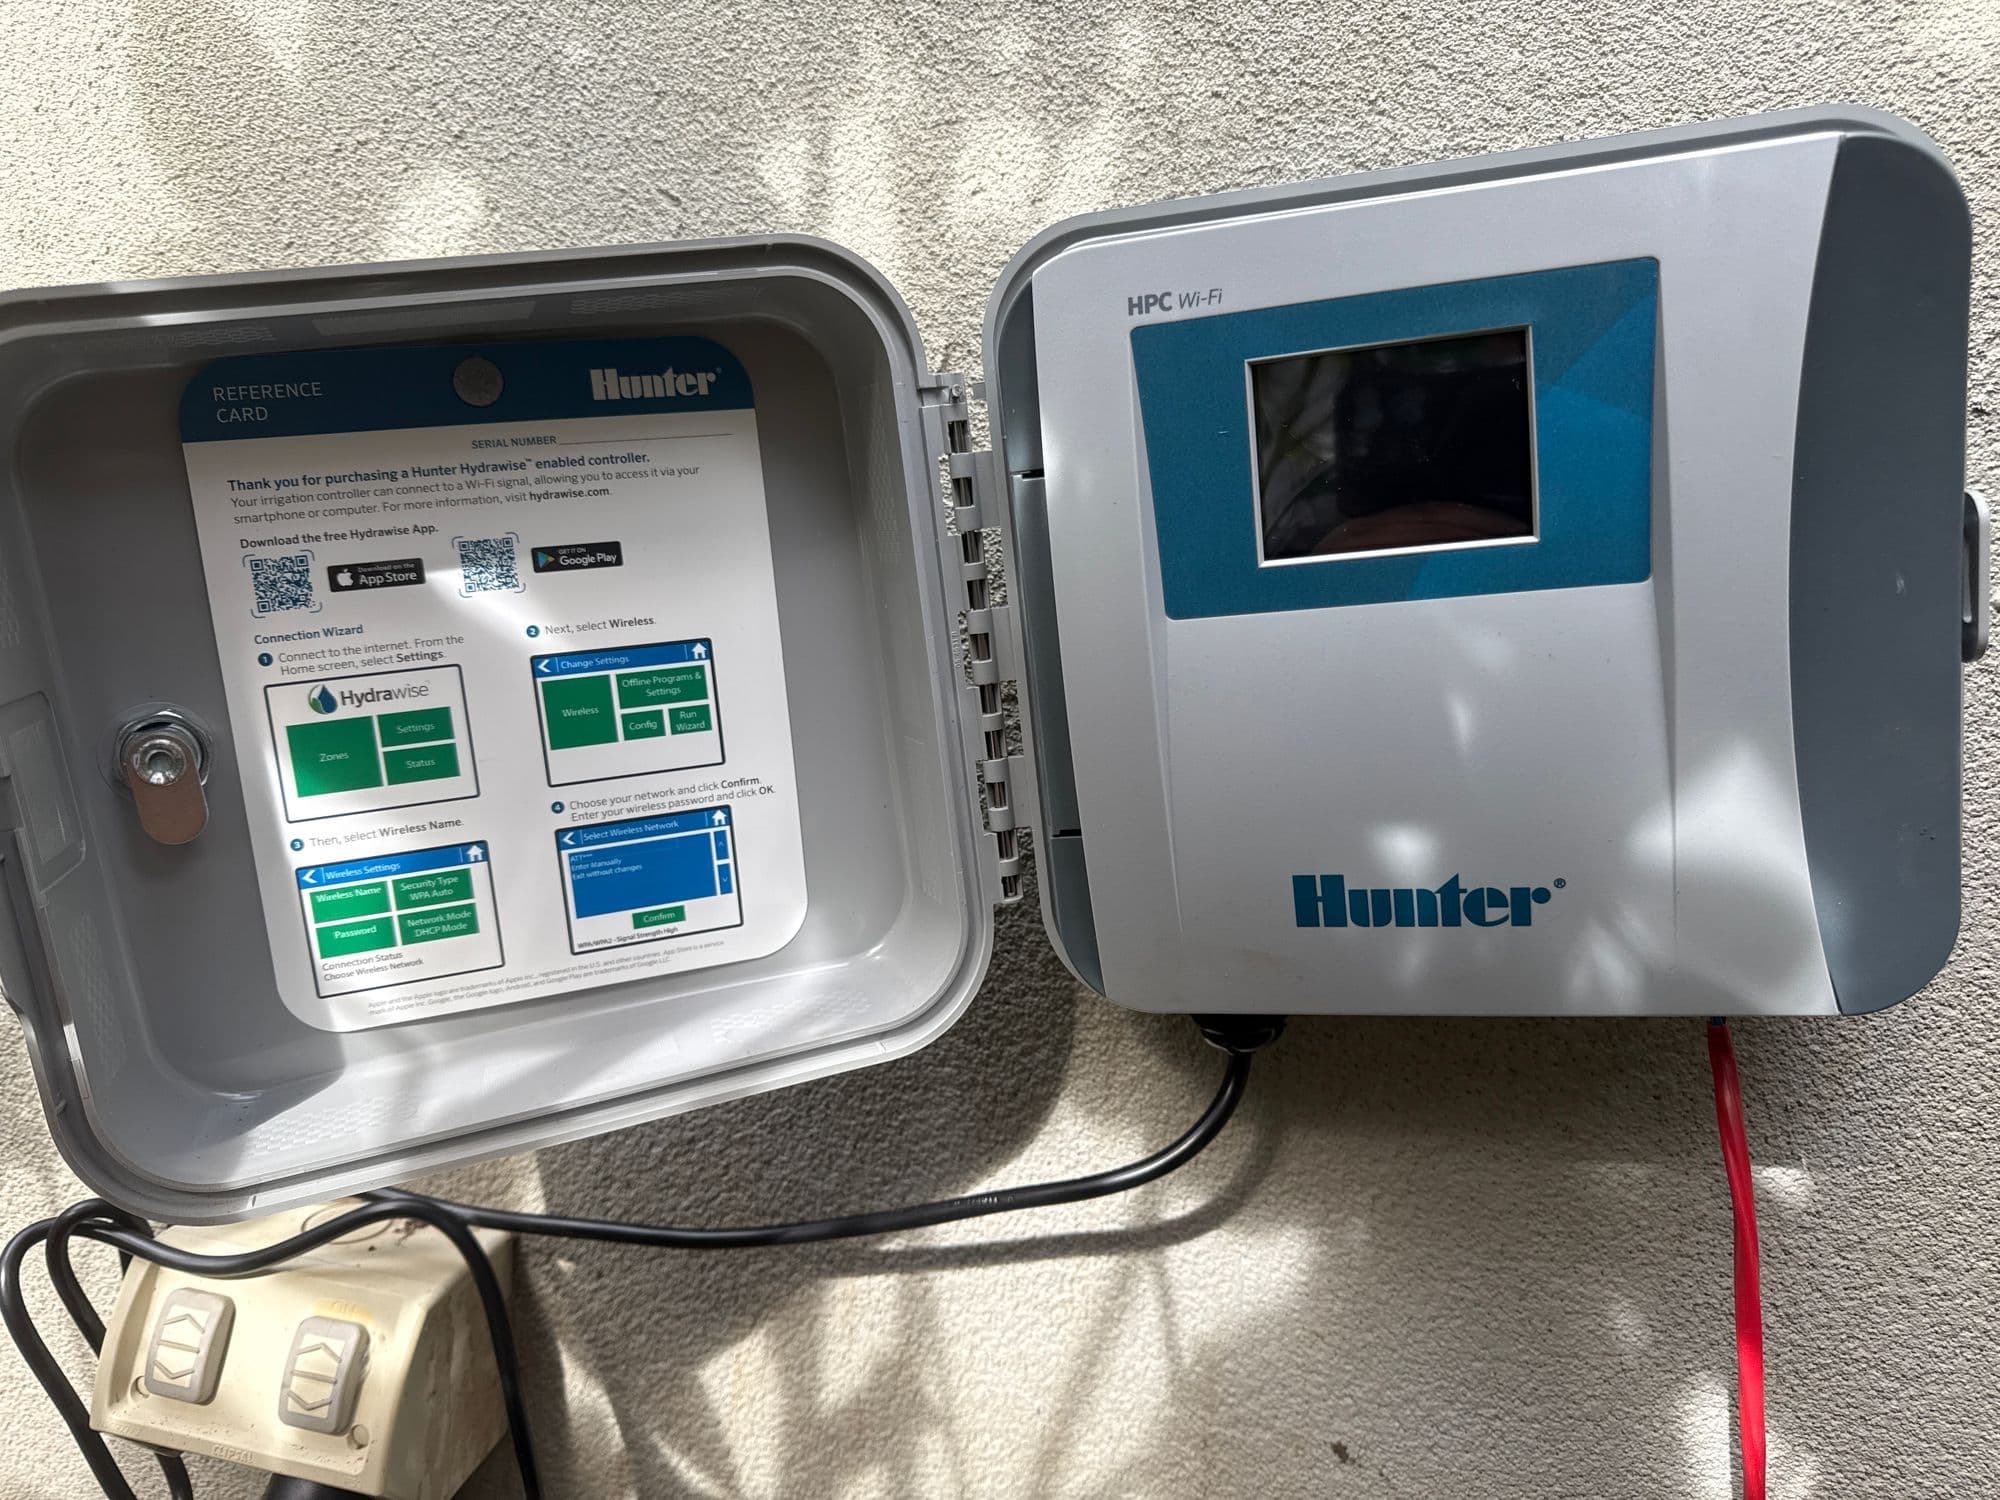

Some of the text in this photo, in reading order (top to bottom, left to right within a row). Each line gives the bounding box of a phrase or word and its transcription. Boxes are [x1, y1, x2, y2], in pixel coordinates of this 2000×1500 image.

[1128, 288, 1222, 316] HPC Wi-Fi
[213, 382, 322, 401] REFERENCE
[217, 407, 268, 423] CARD
[471, 435, 557, 449] SERIAL NUMBER
[228, 478, 272, 492] Thank
[275, 478, 299, 491] you
[303, 475, 322, 486] for
[325, 469, 398, 487] purchasing
[401, 470, 409, 478] a
[412, 466, 457, 479] Hunter
[535, 455, 586, 470] enabled
[588, 453, 650, 466] controller.
[231, 466, 700, 508] Your irrigation controller can connect to a Wi-Fi signal, allowing you to access it via your
[234, 510, 306, 525] smartphone
[308, 508, 320, 518] or
[322, 504, 380, 519] computer.
[383, 501, 401, 512] For
[404, 500, 433, 510] more
[435, 495, 503, 509] information,
[505, 493, 527, 502] visit
[240, 524, 438, 549] Download the free Hydrawise App.
[560, 552, 617, 566] Google Play
[358, 564, 392, 573] Download
[360, 571, 417, 587] App Store
[545, 623, 574, 635] Next,
[576, 621, 608, 632] select
[609, 615, 657, 629] Wireless.
[254, 624, 363, 644] Connection Wizard
[279, 650, 326, 663] Connect
[328, 647, 341, 658] to
[343, 645, 362, 656] the
[364, 641, 412, 654] internet.
[414, 637, 444, 649] From
[446, 635, 464, 645] the
[281, 662, 315, 675] Home
[317, 661, 359, 672] screen,
[361, 655, 394, 667] select
[561, 655, 630, 672] Change Settings
[622, 677, 651, 688] Offline
[653, 673, 694, 686] Programs
[646, 685, 681, 697] Settings
[562, 706, 600, 718] Wireless
[680, 711, 697, 719] Run
[397, 722, 435, 734] Settings
[629, 719, 658, 731] Config
[676, 720, 705, 731] Wizard
[320, 752, 349, 763] Zones
[406, 758, 436, 768] Status
[570, 798, 608, 811] Choose
[610, 795, 632, 807] your
[634, 788, 676, 801] network
[678, 785, 696, 797] and
[698, 781, 720, 793] click
[571, 811, 600, 823] Enter
[601, 808, 624, 820] your
[626, 801, 667, 814] wireless
[668, 795, 715, 810] password
[717, 790, 734, 802] and
[736, 787, 757, 799] click
[310, 834, 341, 847] Then,
[344, 829, 377, 843] select
[379, 823, 427, 837] Wireless
[583, 819, 679, 841] Select Wireless Network
[325, 862, 400, 881] Wireless Settings
[400, 874, 459, 890] Security Type
[316, 886, 382, 903] Wireless Name
[409, 887, 454, 901] WPA Auto
[407, 908, 472, 927] Network Mode
[643, 911, 676, 923] Confirm
[334, 925, 377, 939] Password
[414, 921, 468, 938] DHCP Mode
[617, 933, 636, 943] Signal
[636, 929, 664, 939] Strength
[664, 926, 679, 934] High
[322, 951, 403, 972] Connection Status
[324, 957, 424, 982] Choose Wireless Network
